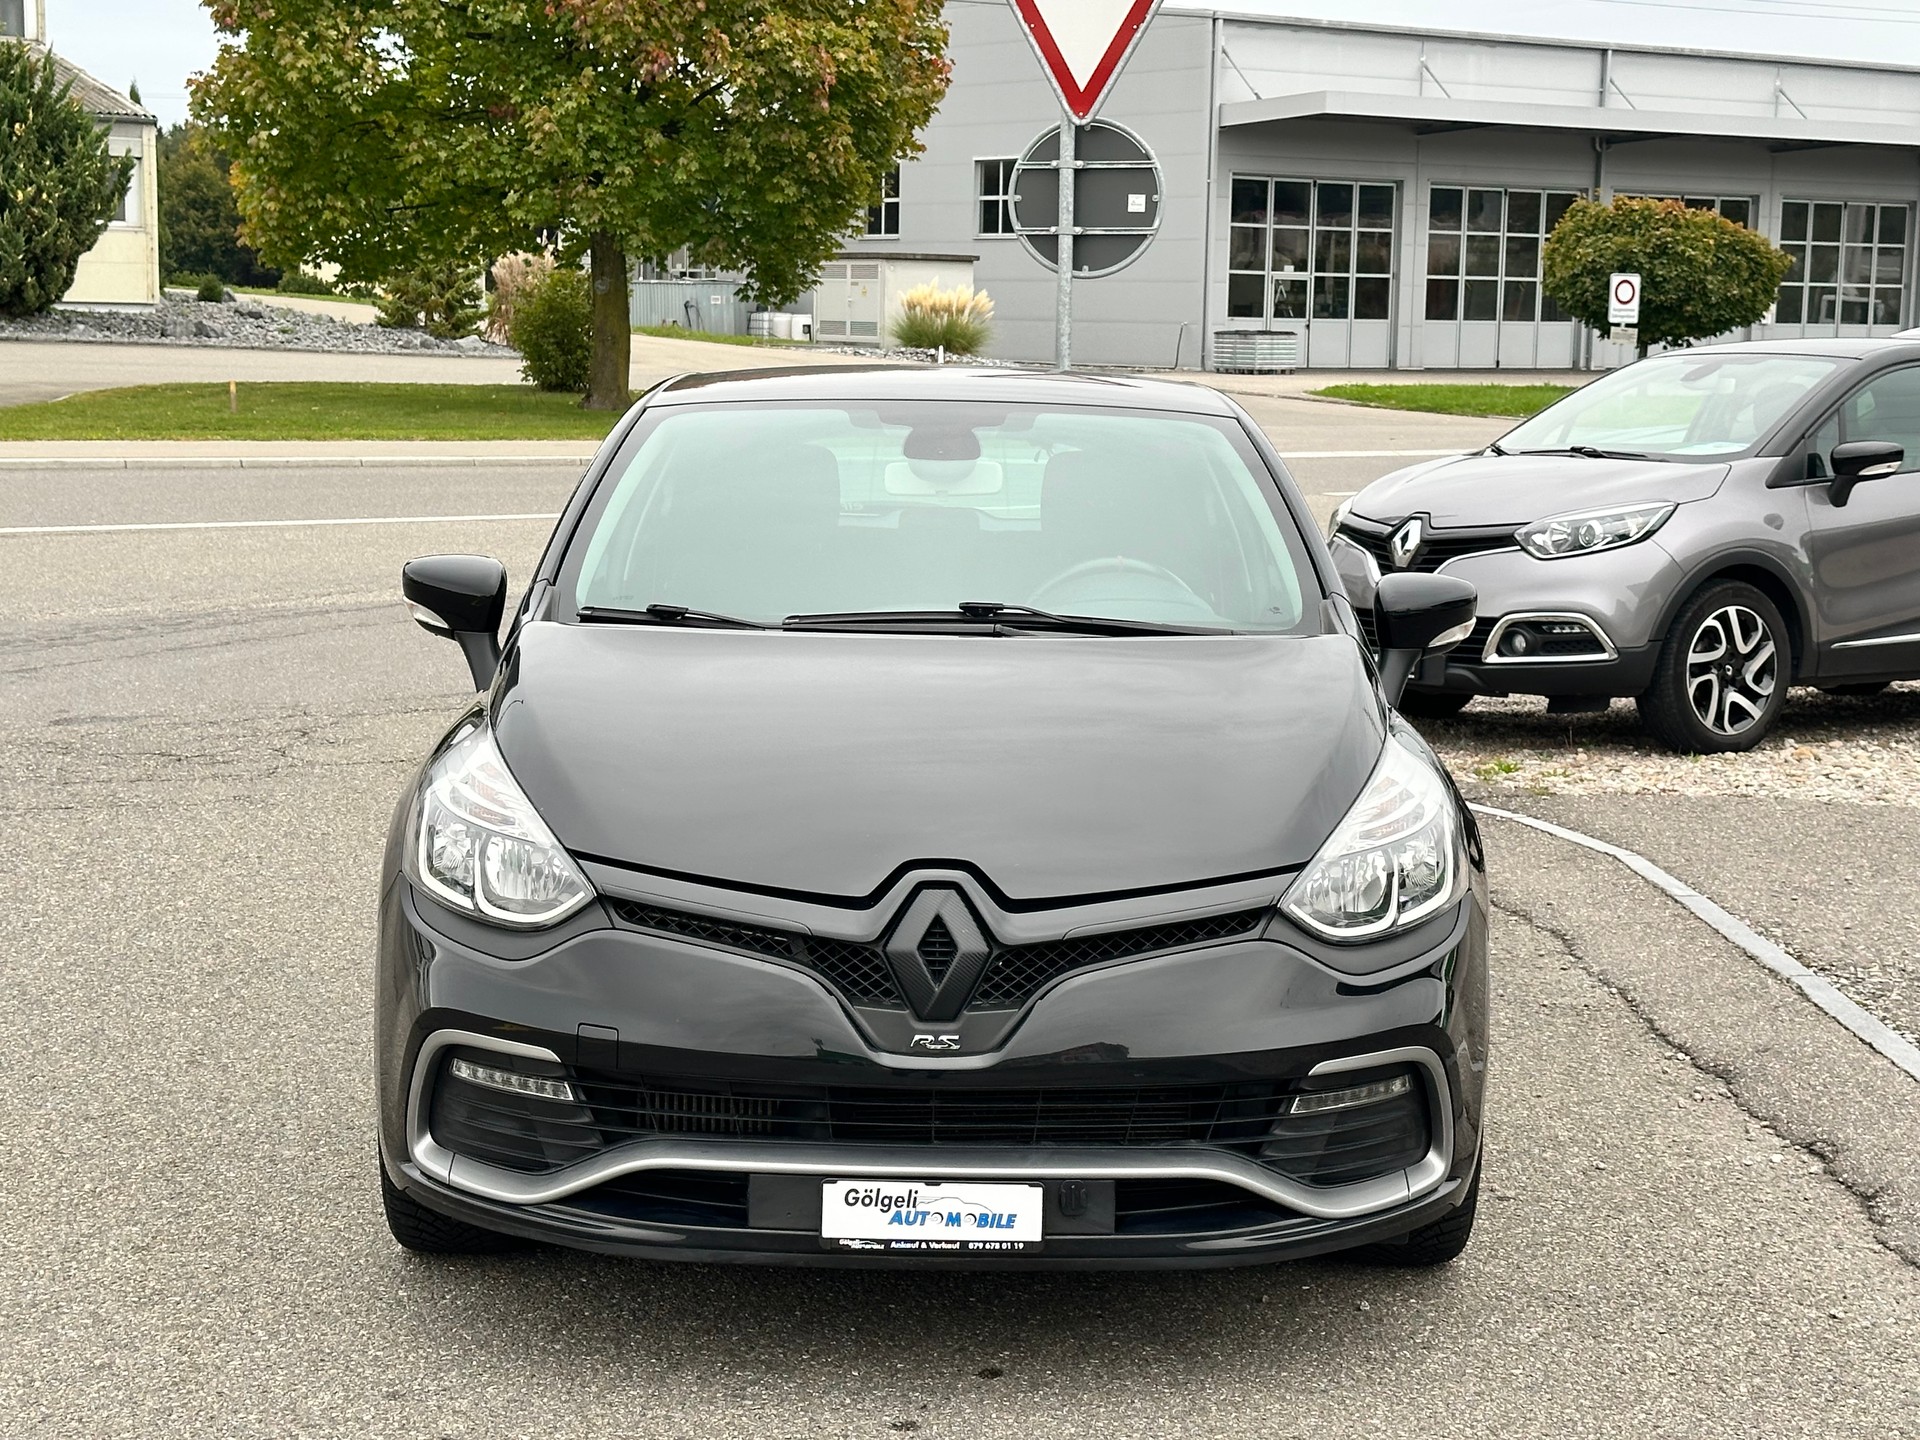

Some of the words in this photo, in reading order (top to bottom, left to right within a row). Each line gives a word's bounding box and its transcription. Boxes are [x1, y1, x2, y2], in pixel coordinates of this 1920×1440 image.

[844, 1188, 918, 1213] Gölgeli
[888, 1209, 1017, 1229] AUTOMOBILE
[890, 1240, 920, 1249] Ankauf
[920, 1241, 928, 1249] &
[928, 1241, 961, 1250] Verkauf
